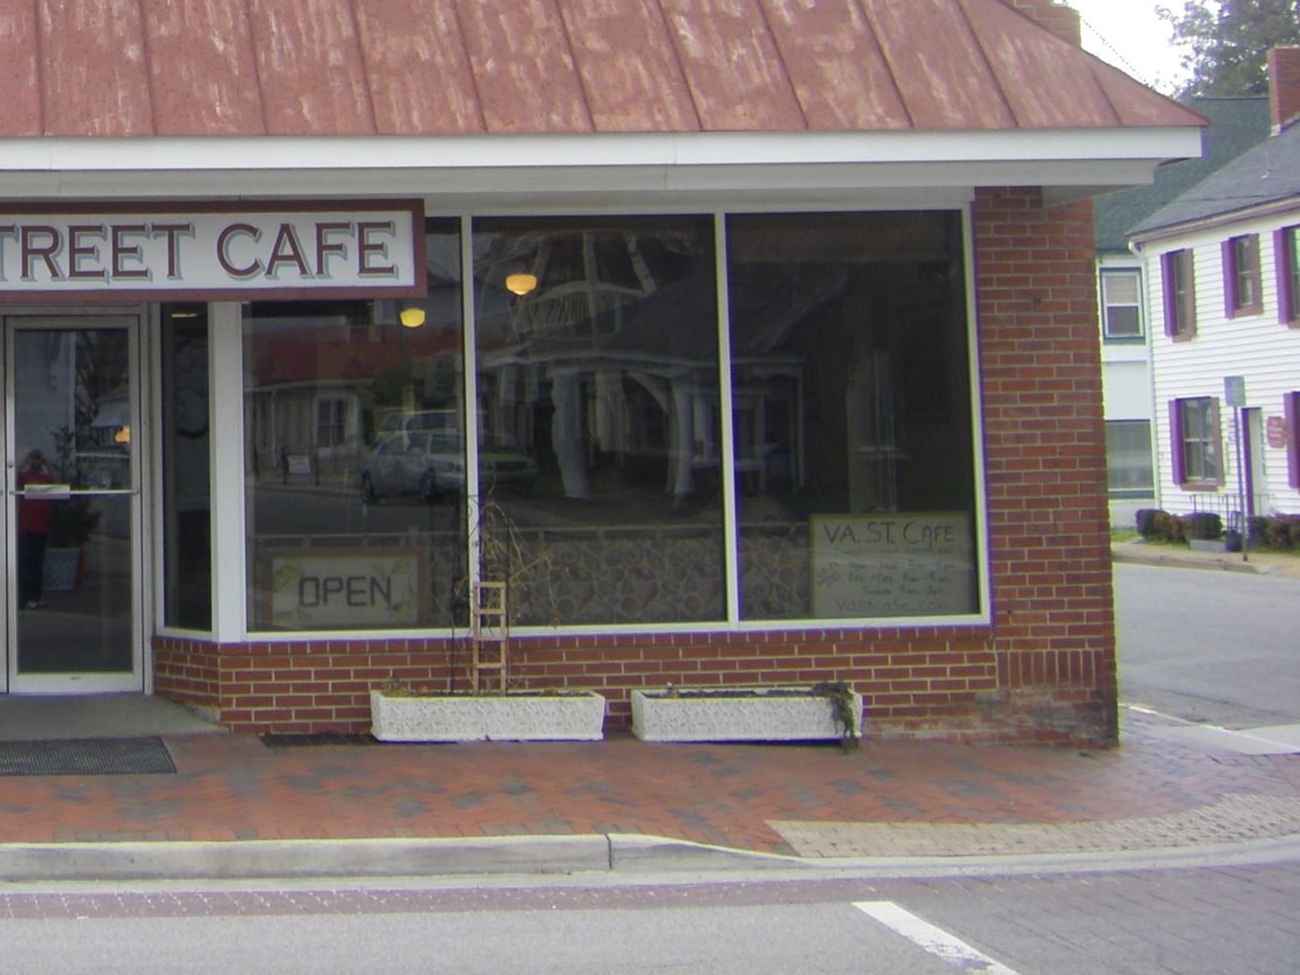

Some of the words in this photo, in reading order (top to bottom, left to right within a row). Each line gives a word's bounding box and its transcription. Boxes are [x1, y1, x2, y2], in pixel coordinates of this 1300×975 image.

[216, 220, 399, 280] CAFE
[824, 525, 860, 543] VA.
[866, 521, 896, 544] ST.
[903, 521, 956, 550] CAFE
[299, 576, 392, 607] OPEN
